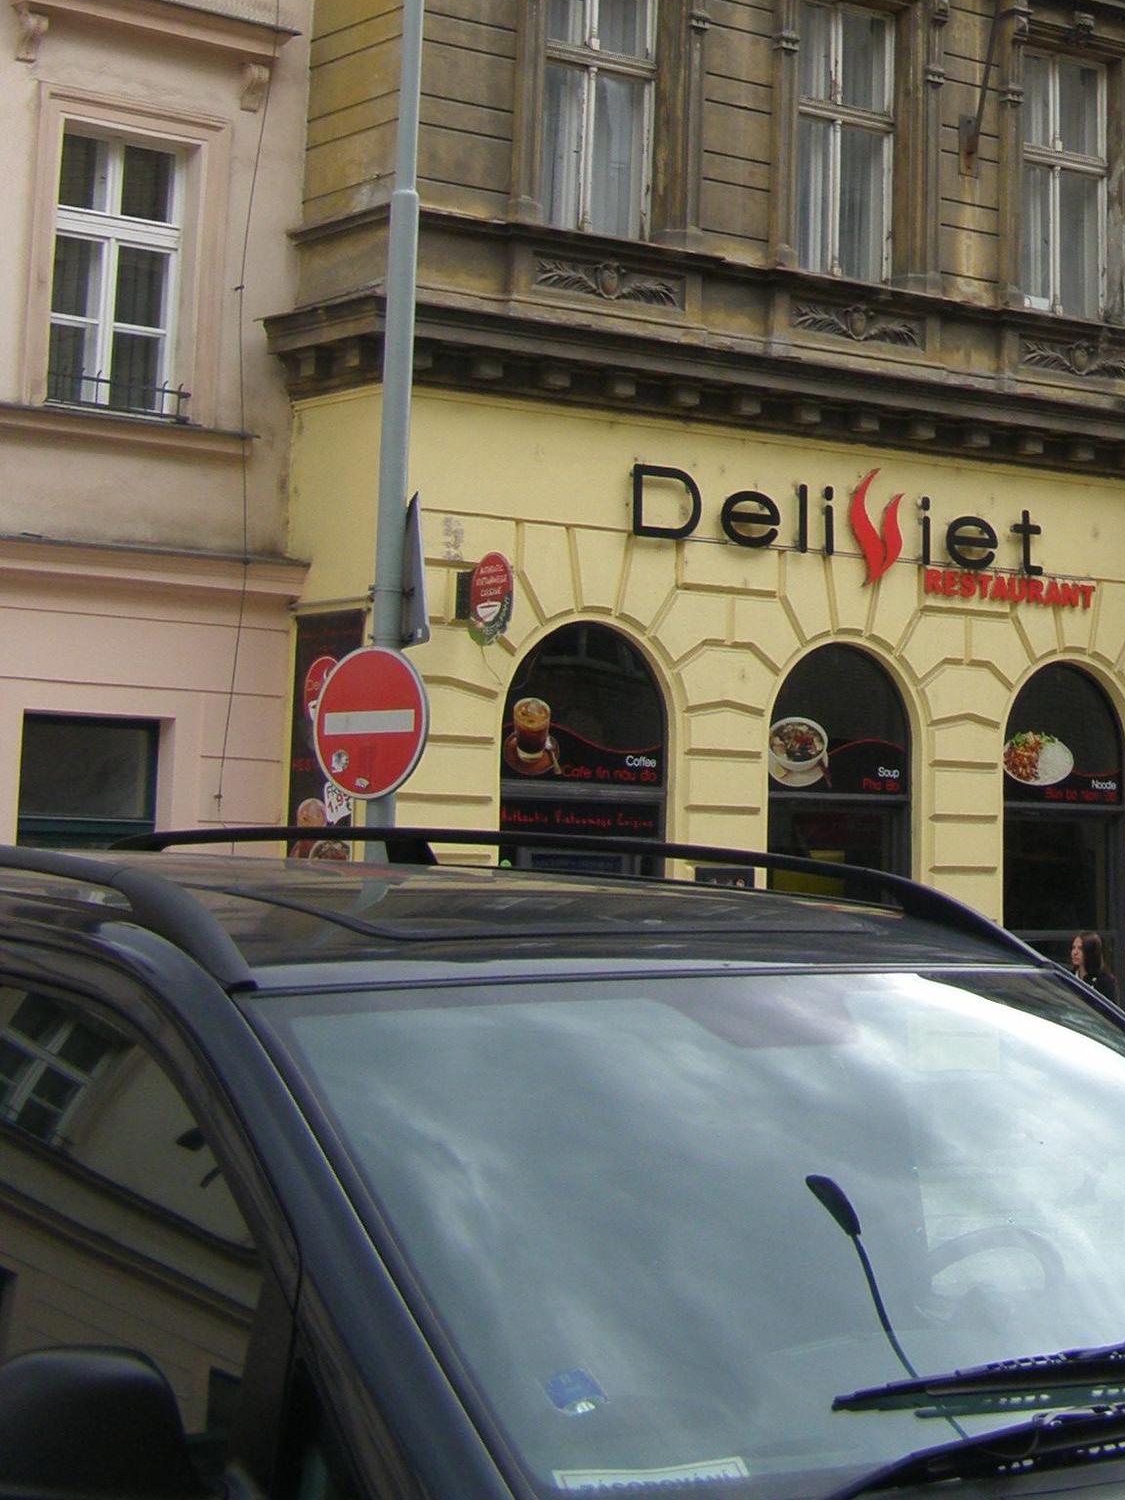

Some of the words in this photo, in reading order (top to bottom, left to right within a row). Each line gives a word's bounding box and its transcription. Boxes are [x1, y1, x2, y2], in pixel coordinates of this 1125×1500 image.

[632, 463, 1044, 586] DeliViet
[924, 568, 1096, 609] RESTAURANT
[625, 755, 657, 768] Coffee
[878, 766, 900, 779] Soup
